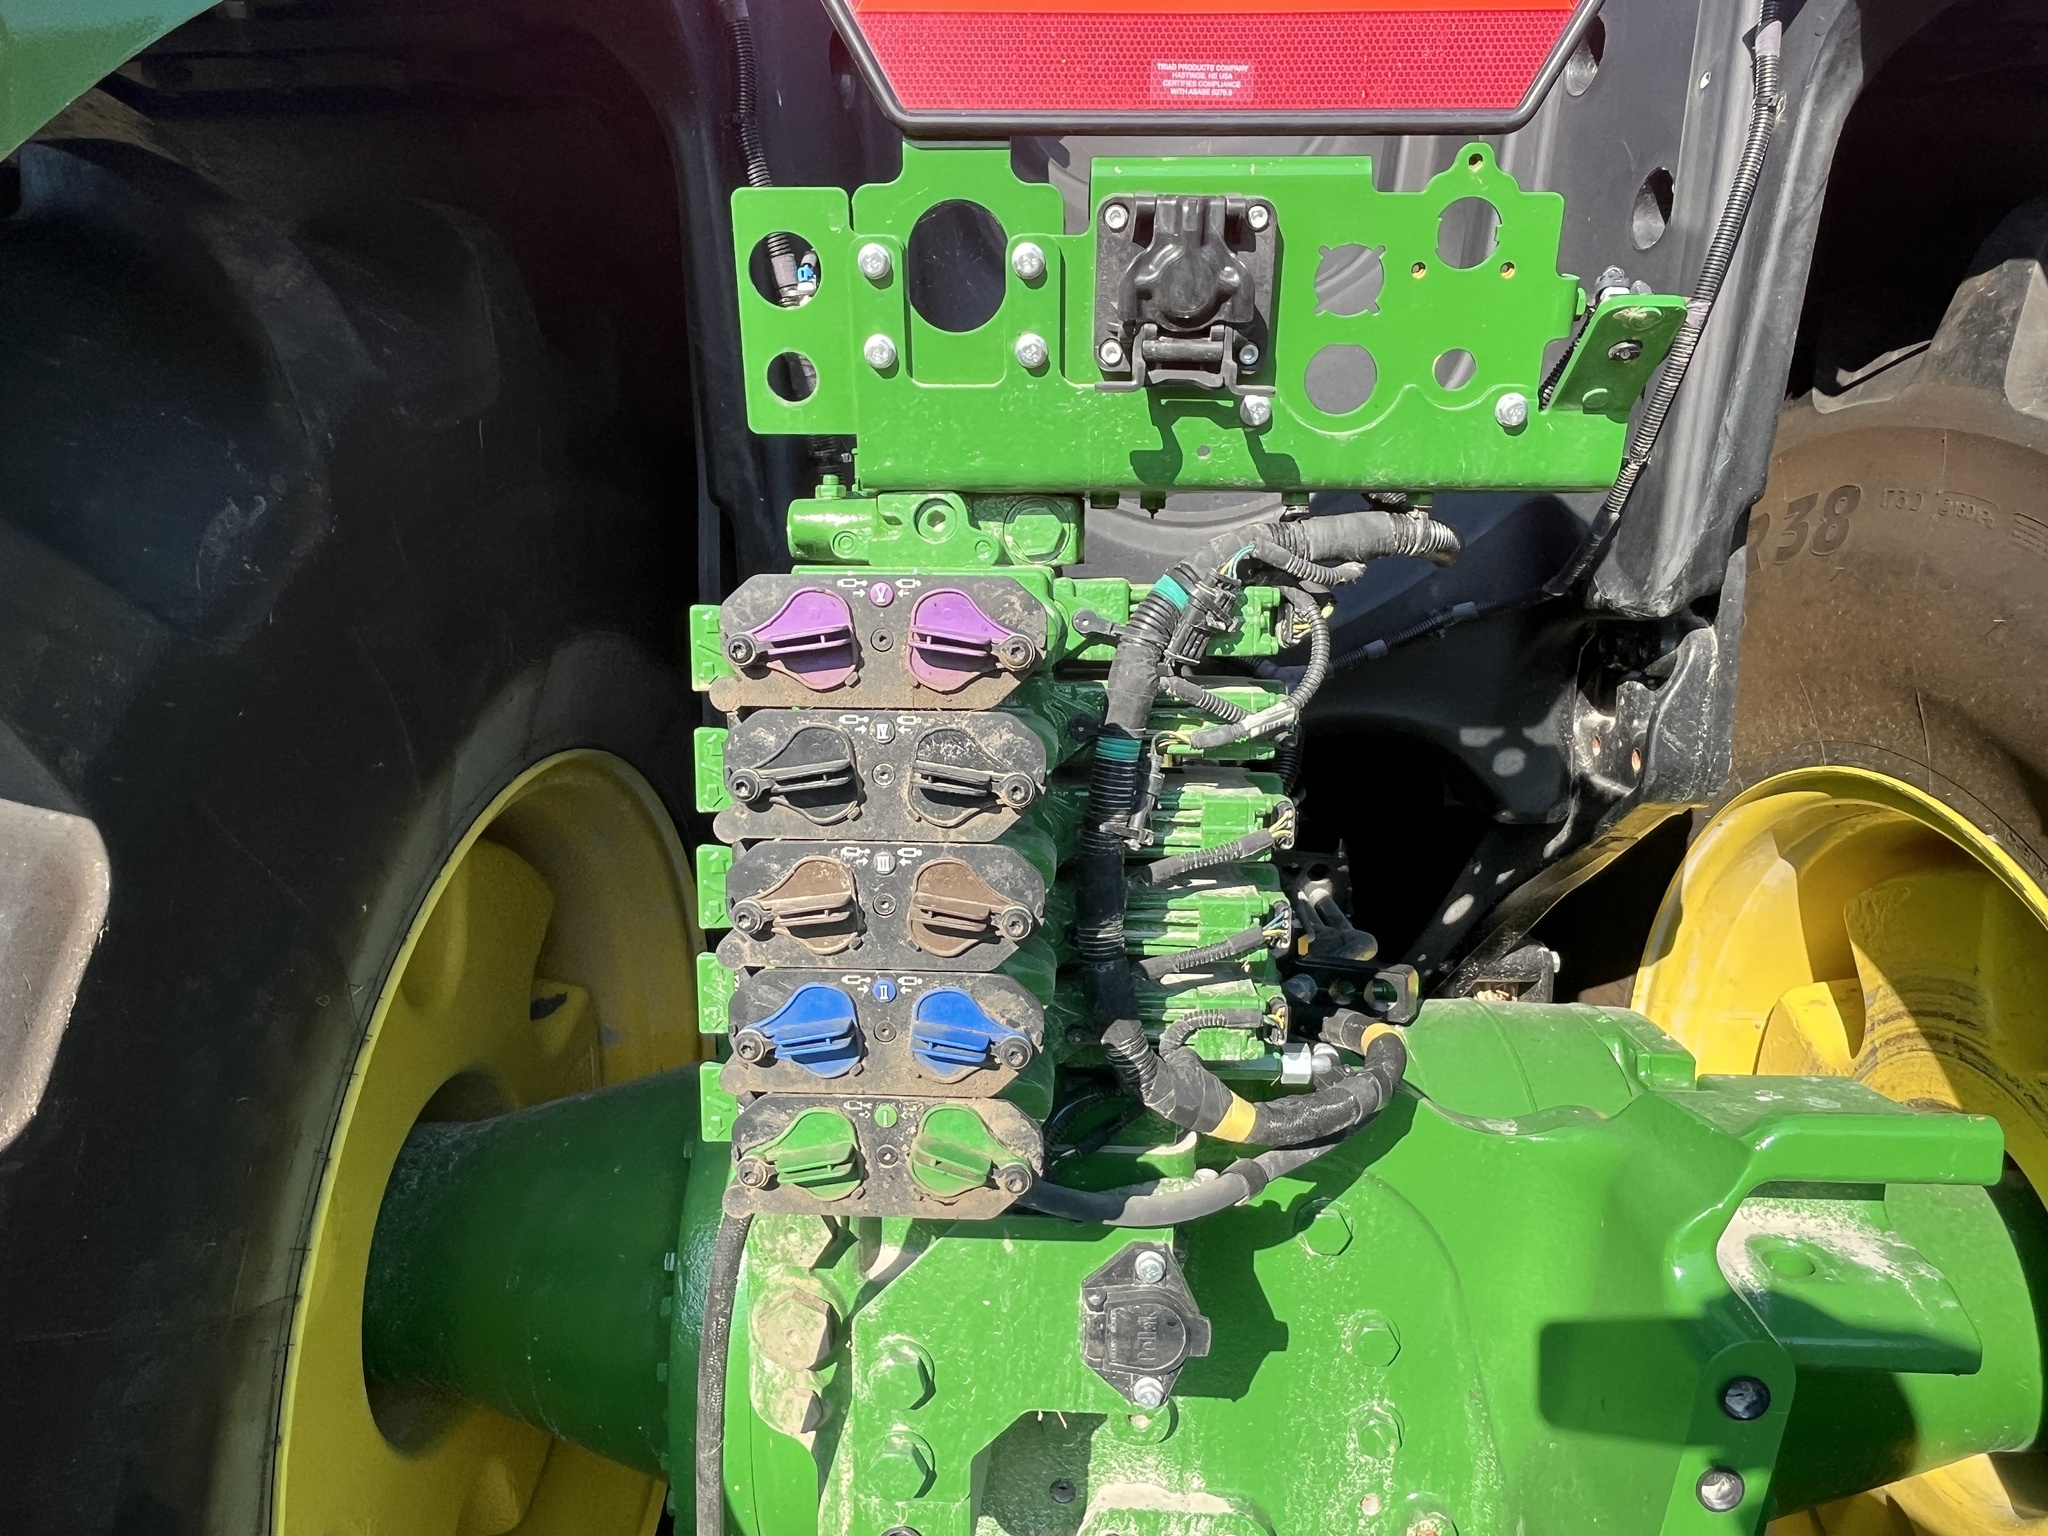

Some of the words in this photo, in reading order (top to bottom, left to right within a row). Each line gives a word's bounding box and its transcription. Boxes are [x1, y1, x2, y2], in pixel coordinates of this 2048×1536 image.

[1157, 63, 1177, 71] TRIAD
[1178, 64, 1215, 72] PRODUCTS
[1216, 64, 1250, 72] COMPANY
[1198, 80, 1242, 88] COMPLIANCE
[1219, 72, 1233, 80] USA
[874, 586, 888, 603] V
[876, 723, 889, 740] IV
[876, 855, 890, 872] III
[879, 984, 889, 1000] II
